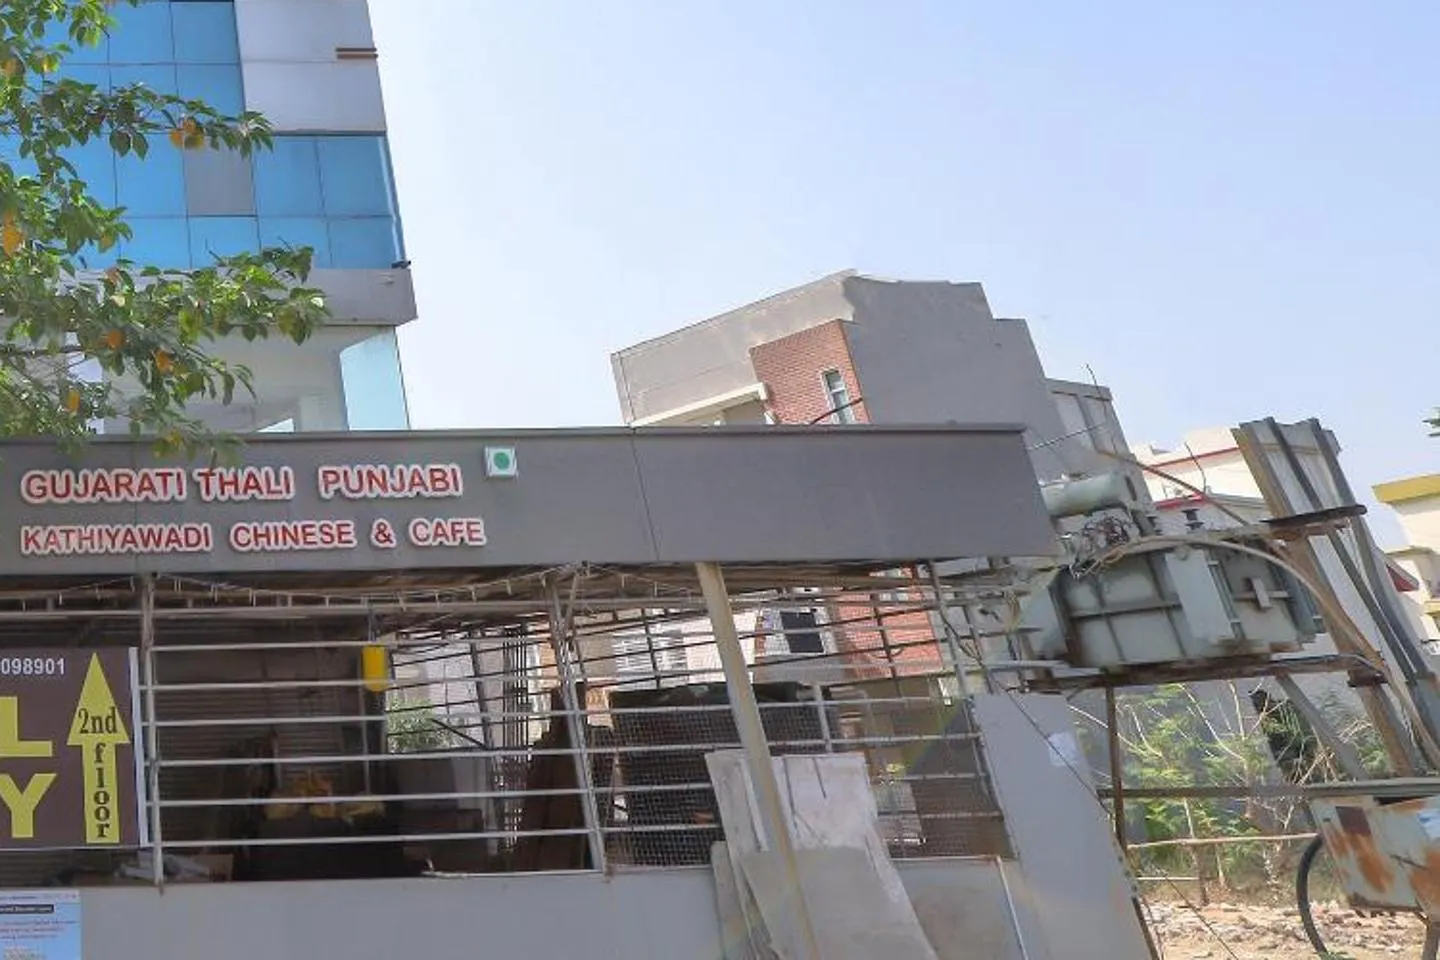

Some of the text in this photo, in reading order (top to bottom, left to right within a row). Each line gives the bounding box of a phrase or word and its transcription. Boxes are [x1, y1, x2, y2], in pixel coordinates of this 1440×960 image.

[22, 464, 464, 503] GUJARATI THALI PUNJABI
[21, 517, 487, 554] KATHIYAWADI CHINESE & CAFE
[78, 706, 118, 734] 2nd
